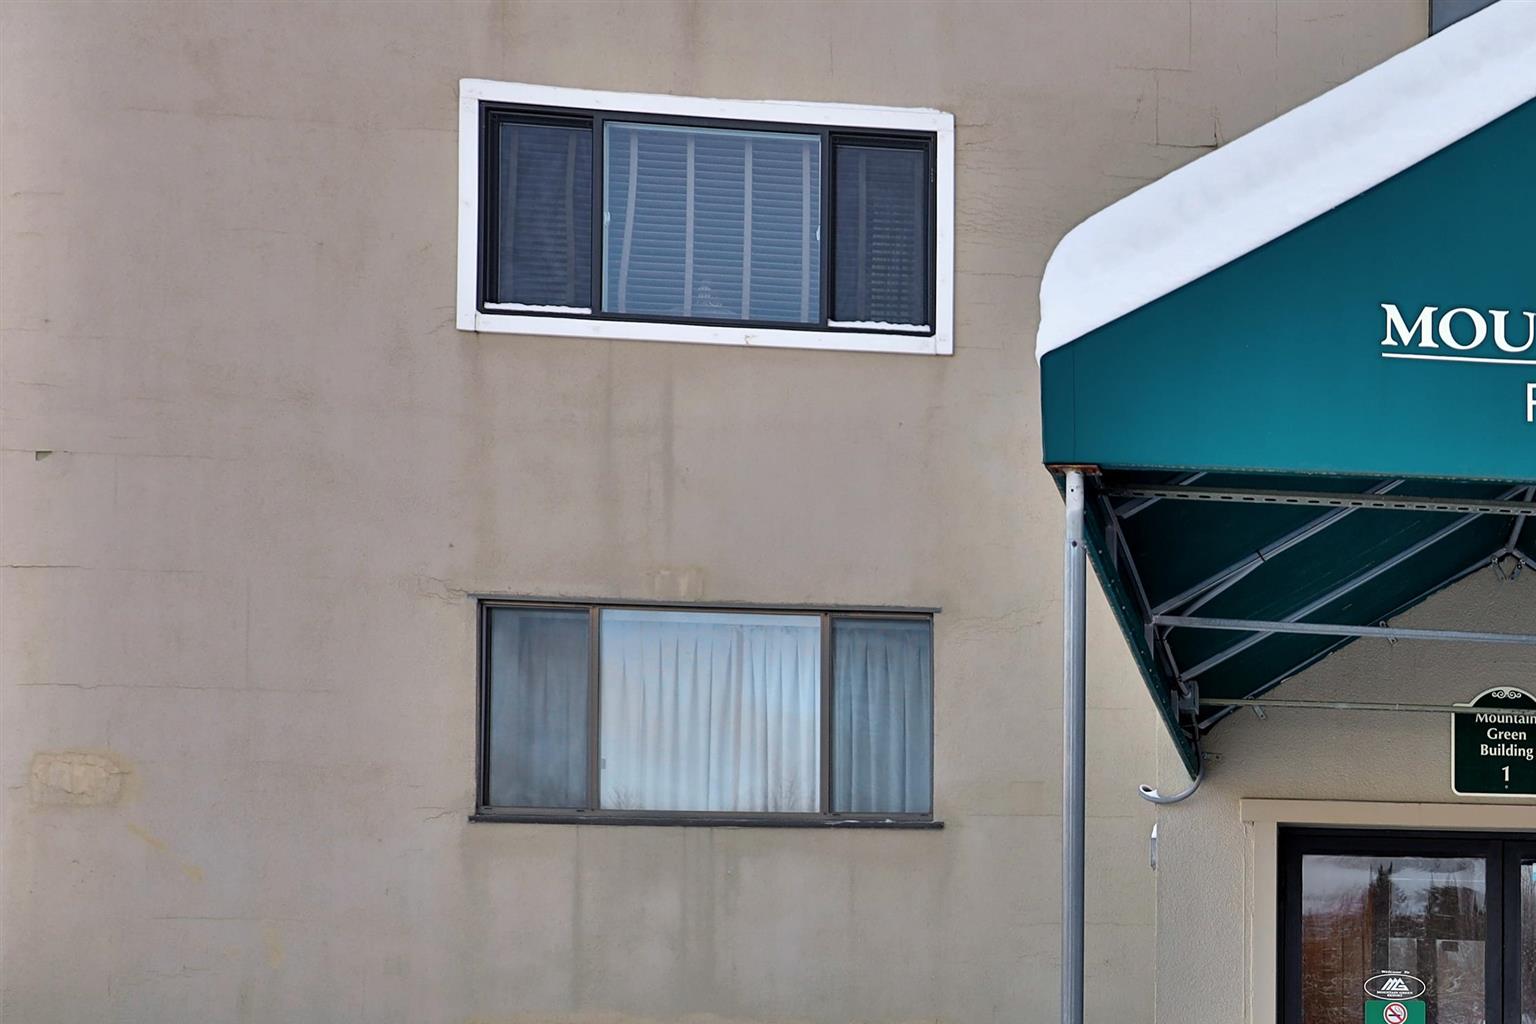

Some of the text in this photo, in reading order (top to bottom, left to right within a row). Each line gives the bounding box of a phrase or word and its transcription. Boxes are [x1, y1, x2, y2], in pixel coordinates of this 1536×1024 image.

[1486, 727, 1527, 741] Green
[1479, 743, 1534, 761] Building
[1501, 765, 1510, 782] 1
